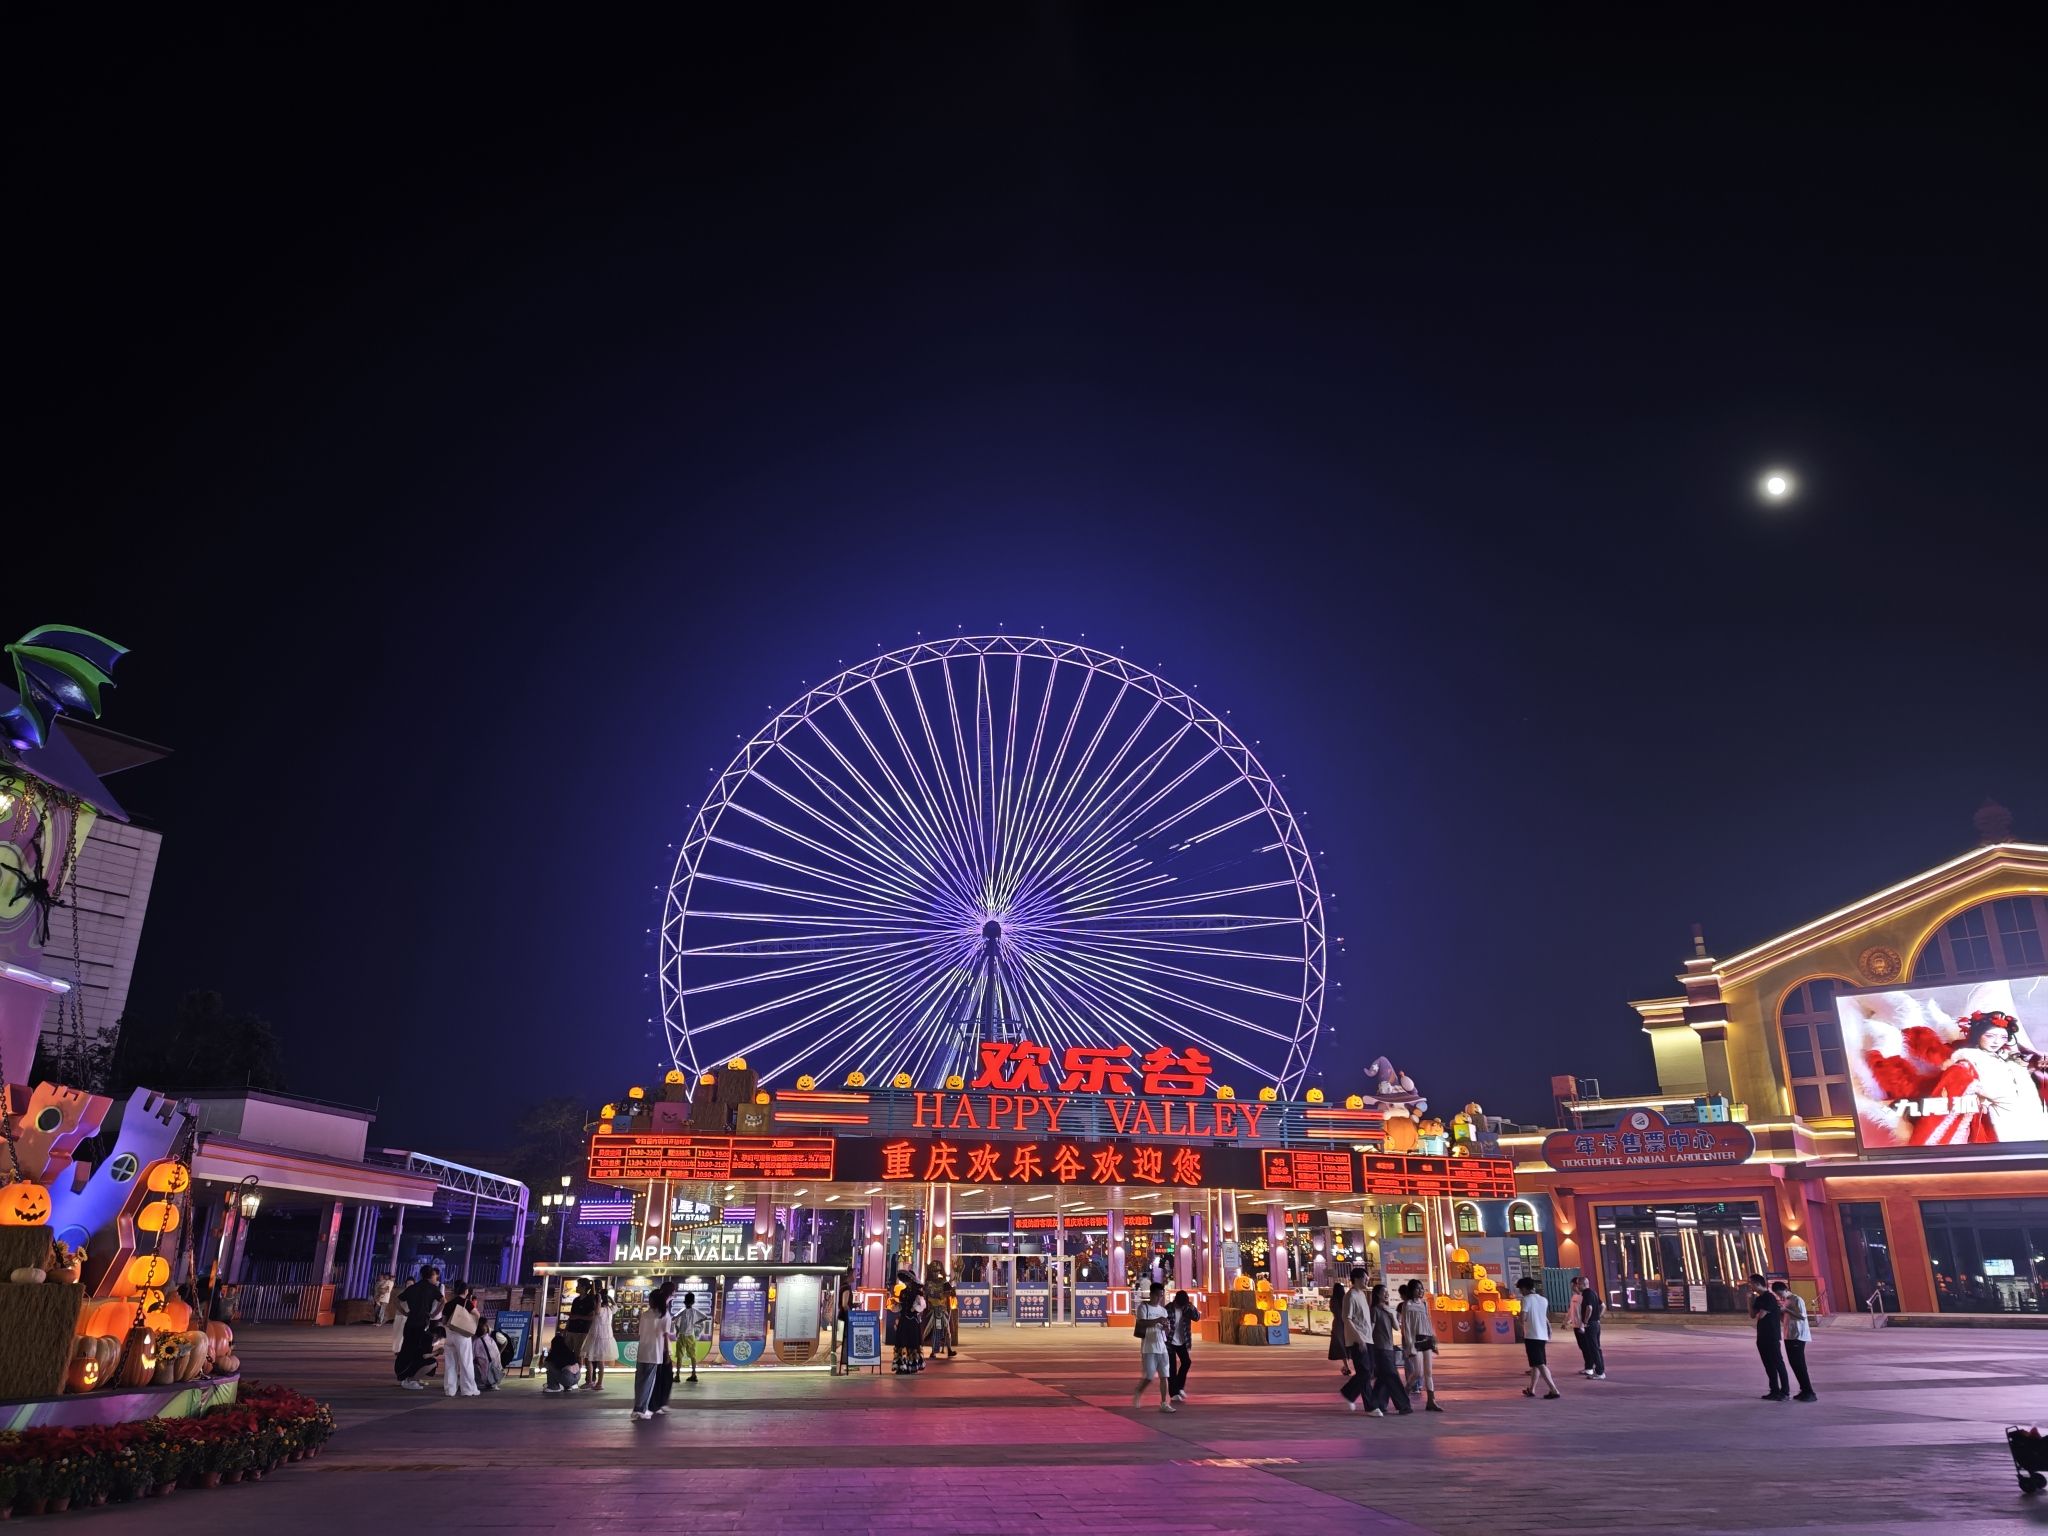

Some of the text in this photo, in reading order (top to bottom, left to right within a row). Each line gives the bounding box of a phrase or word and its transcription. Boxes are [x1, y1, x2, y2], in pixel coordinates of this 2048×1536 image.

[972, 1042, 1213, 1096] 欢乐谷
[913, 1092, 1268, 1138] HAPPY VALLEY
[1574, 1129, 1715, 1157] 年卡售票中心
[1626, 1154, 1666, 1165] ANNUAL
[881, 1140, 1202, 1186] 重庆欢乐谷欢迎您
[615, 1244, 773, 1261] HAPPY VALLEY
